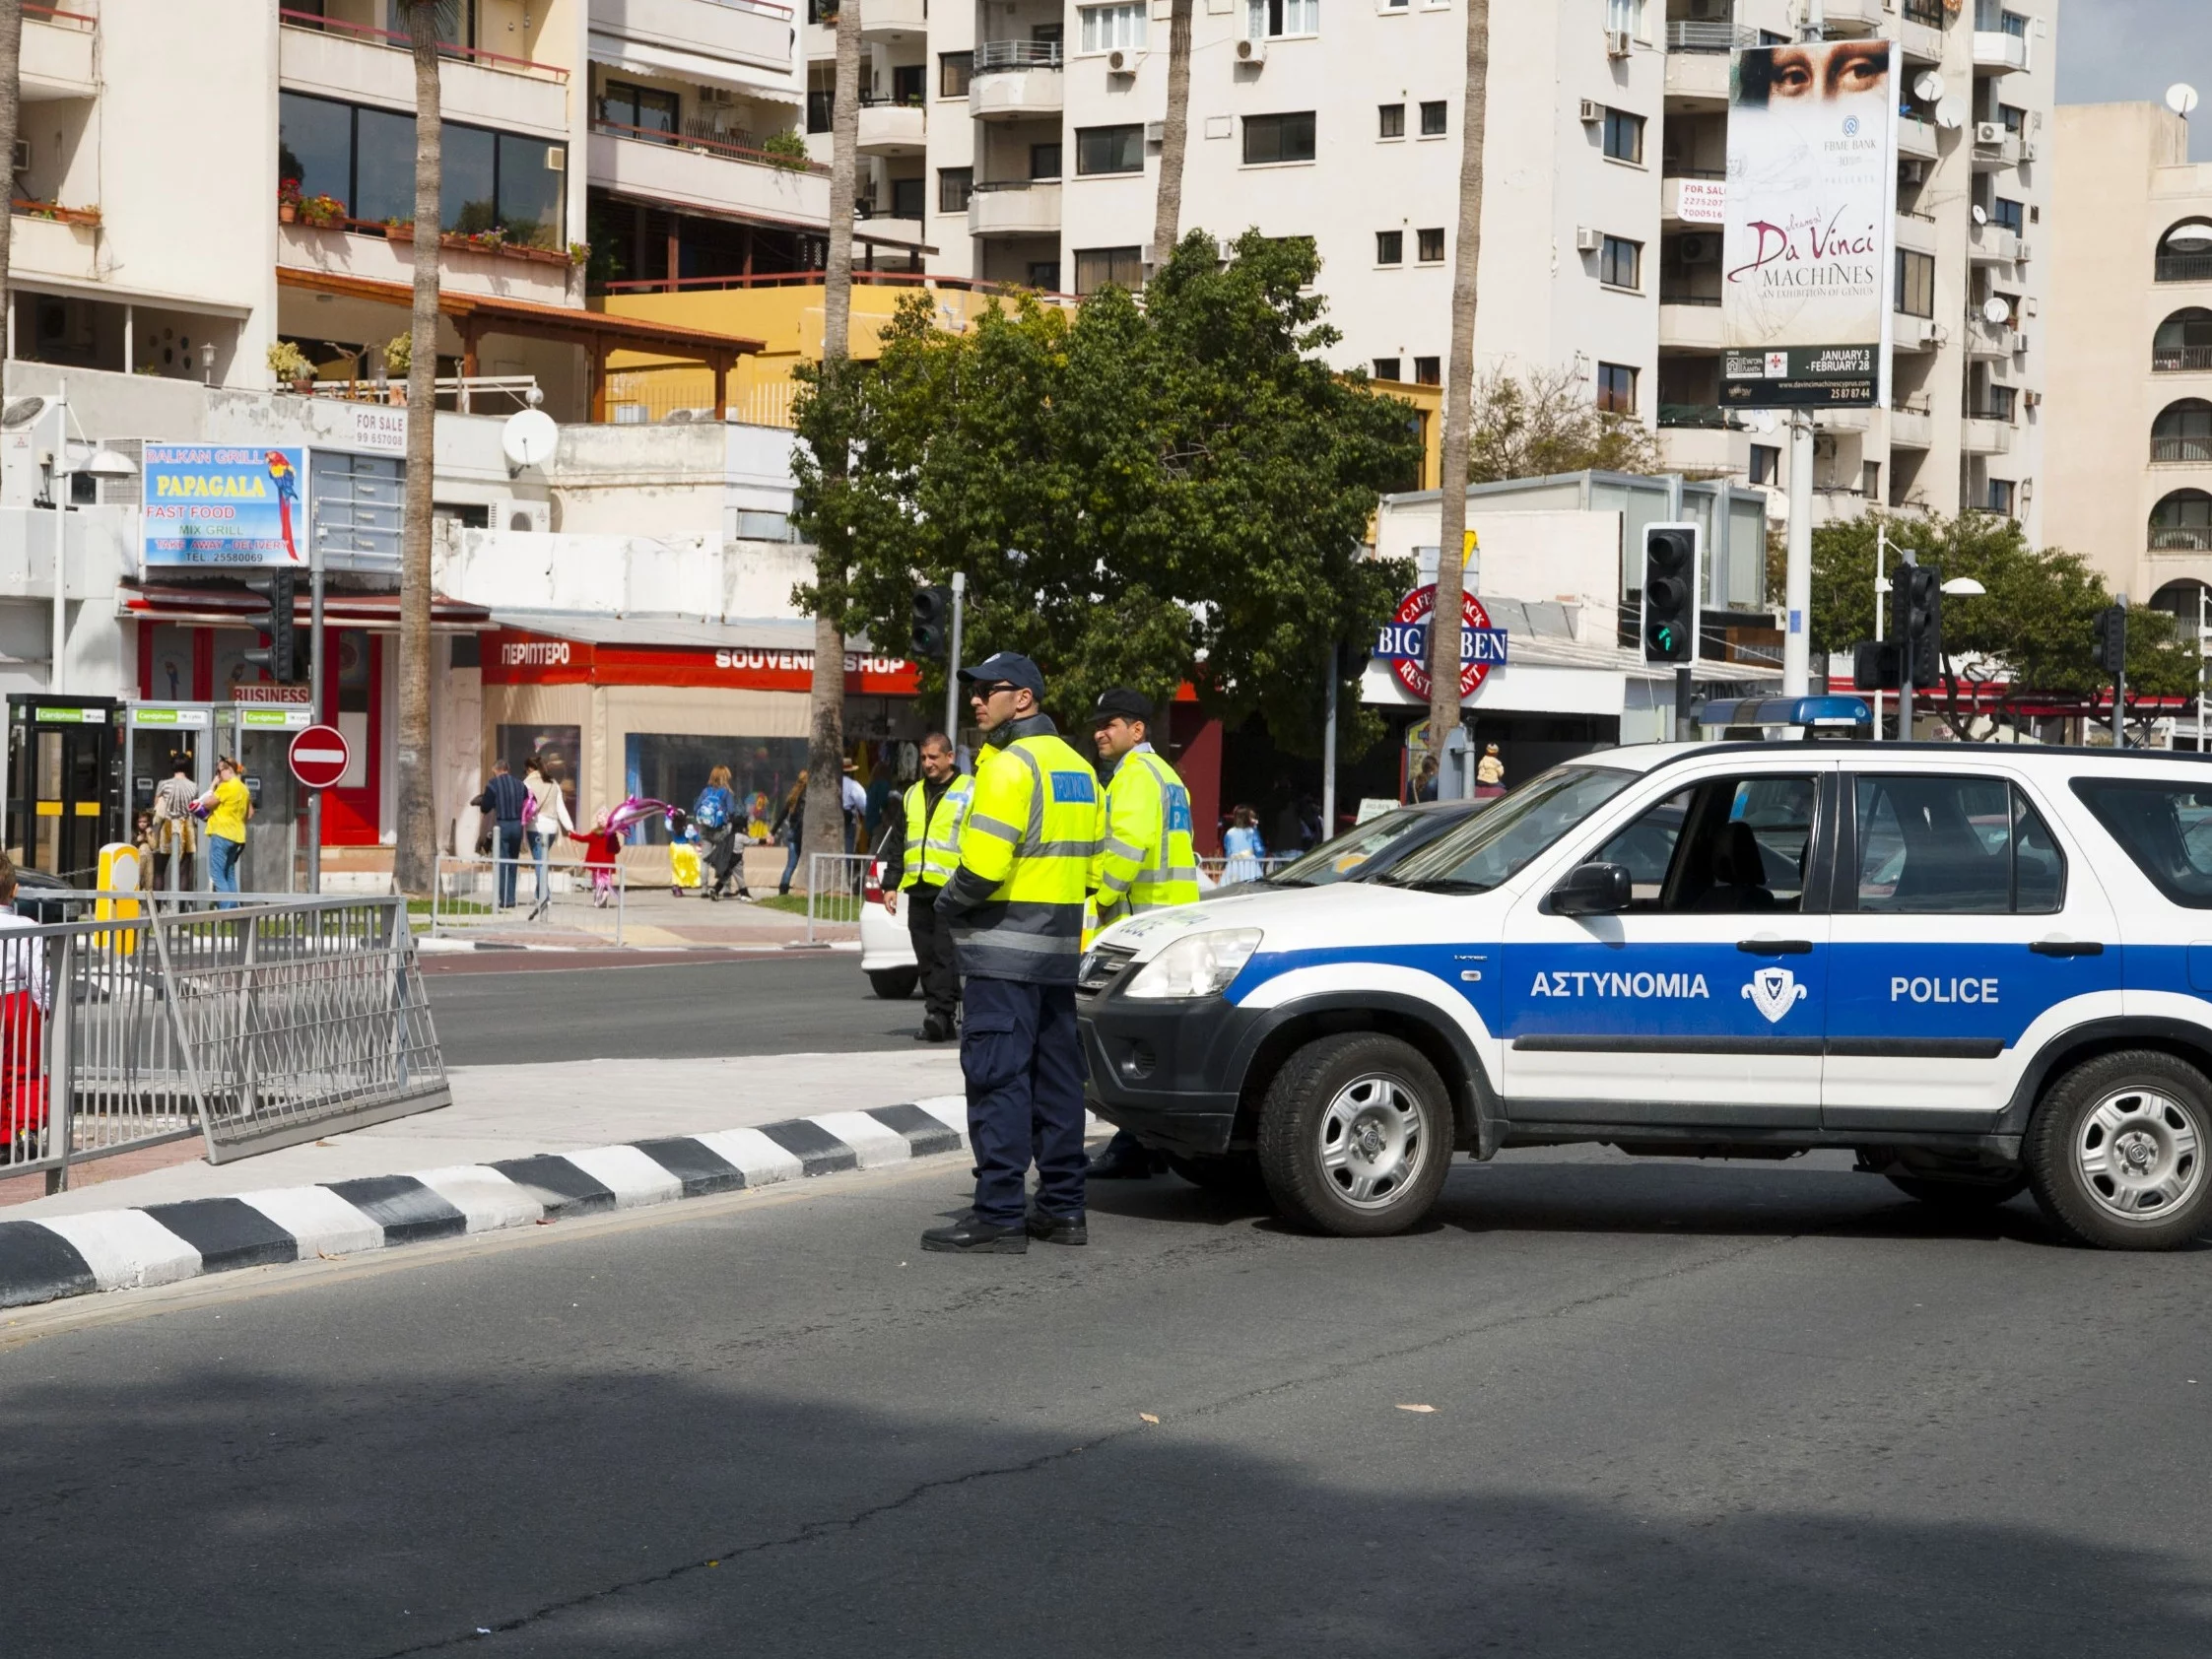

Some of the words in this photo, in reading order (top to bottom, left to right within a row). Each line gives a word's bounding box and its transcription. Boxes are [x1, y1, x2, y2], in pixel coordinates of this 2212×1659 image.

[1852, 139, 1877, 150] BANK
[1685, 184, 1704, 194] FOR
[1684, 197, 1723, 206] 2275207
[1684, 209, 1722, 218] 7000516
[1727, 220, 1800, 283] Da
[1810, 204, 1874, 259] Vinci
[1763, 263, 1874, 288] MACHINES
[1776, 287, 1826, 299] EXHIBITION
[1828, 288, 1839, 297] OF
[1841, 286, 1874, 297] GENIUS
[1821, 350, 1863, 362] JANUARY
[1864, 350, 1870, 361] 3
[1810, 361, 1857, 371] FEBRUARY
[1858, 361, 1870, 371] 28
[1777, 380, 1871, 389] www.davincimachinescyprus.com
[1831, 388, 1841, 399] 25
[1841, 388, 1850, 398] 87
[1850, 388, 1860, 398] 87
[1860, 388, 1870, 398] 44
[357, 414, 376, 430] FOR
[379, 416, 404, 432] SALE
[357, 431, 369, 443] 99
[146, 449, 212, 465] BALKAN
[214, 449, 265, 465] GRILL
[156, 475, 267, 498] PAPAGALA
[145, 505, 185, 519] FAST
[190, 505, 235, 519] FOOD
[179, 525, 201, 536] MIX
[206, 525, 244, 536] GRILL
[156, 540, 186, 551] TAKE
[191, 540, 224, 551] AWAY
[232, 540, 289, 551] DELIVERY
[213, 553, 263, 563] 25580069
[1401, 592, 1433, 623] CAFE
[1461, 599, 1485, 628] ACK
[1378, 627, 1421, 656] BIG
[1460, 631, 1507, 660] BEN
[501, 641, 570, 665] ΠΕΡΙΠΤΕΡΟ
[715, 648, 816, 671] SOUVENI
[843, 653, 905, 674] SHOP
[1399, 660, 1483, 696] RESTNT
[234, 688, 309, 702] BUSINESS
[1530, 971, 1710, 998] ΑΣΤΥΝΟΜΙΑ
[1891, 976, 1999, 1003] POLICE
